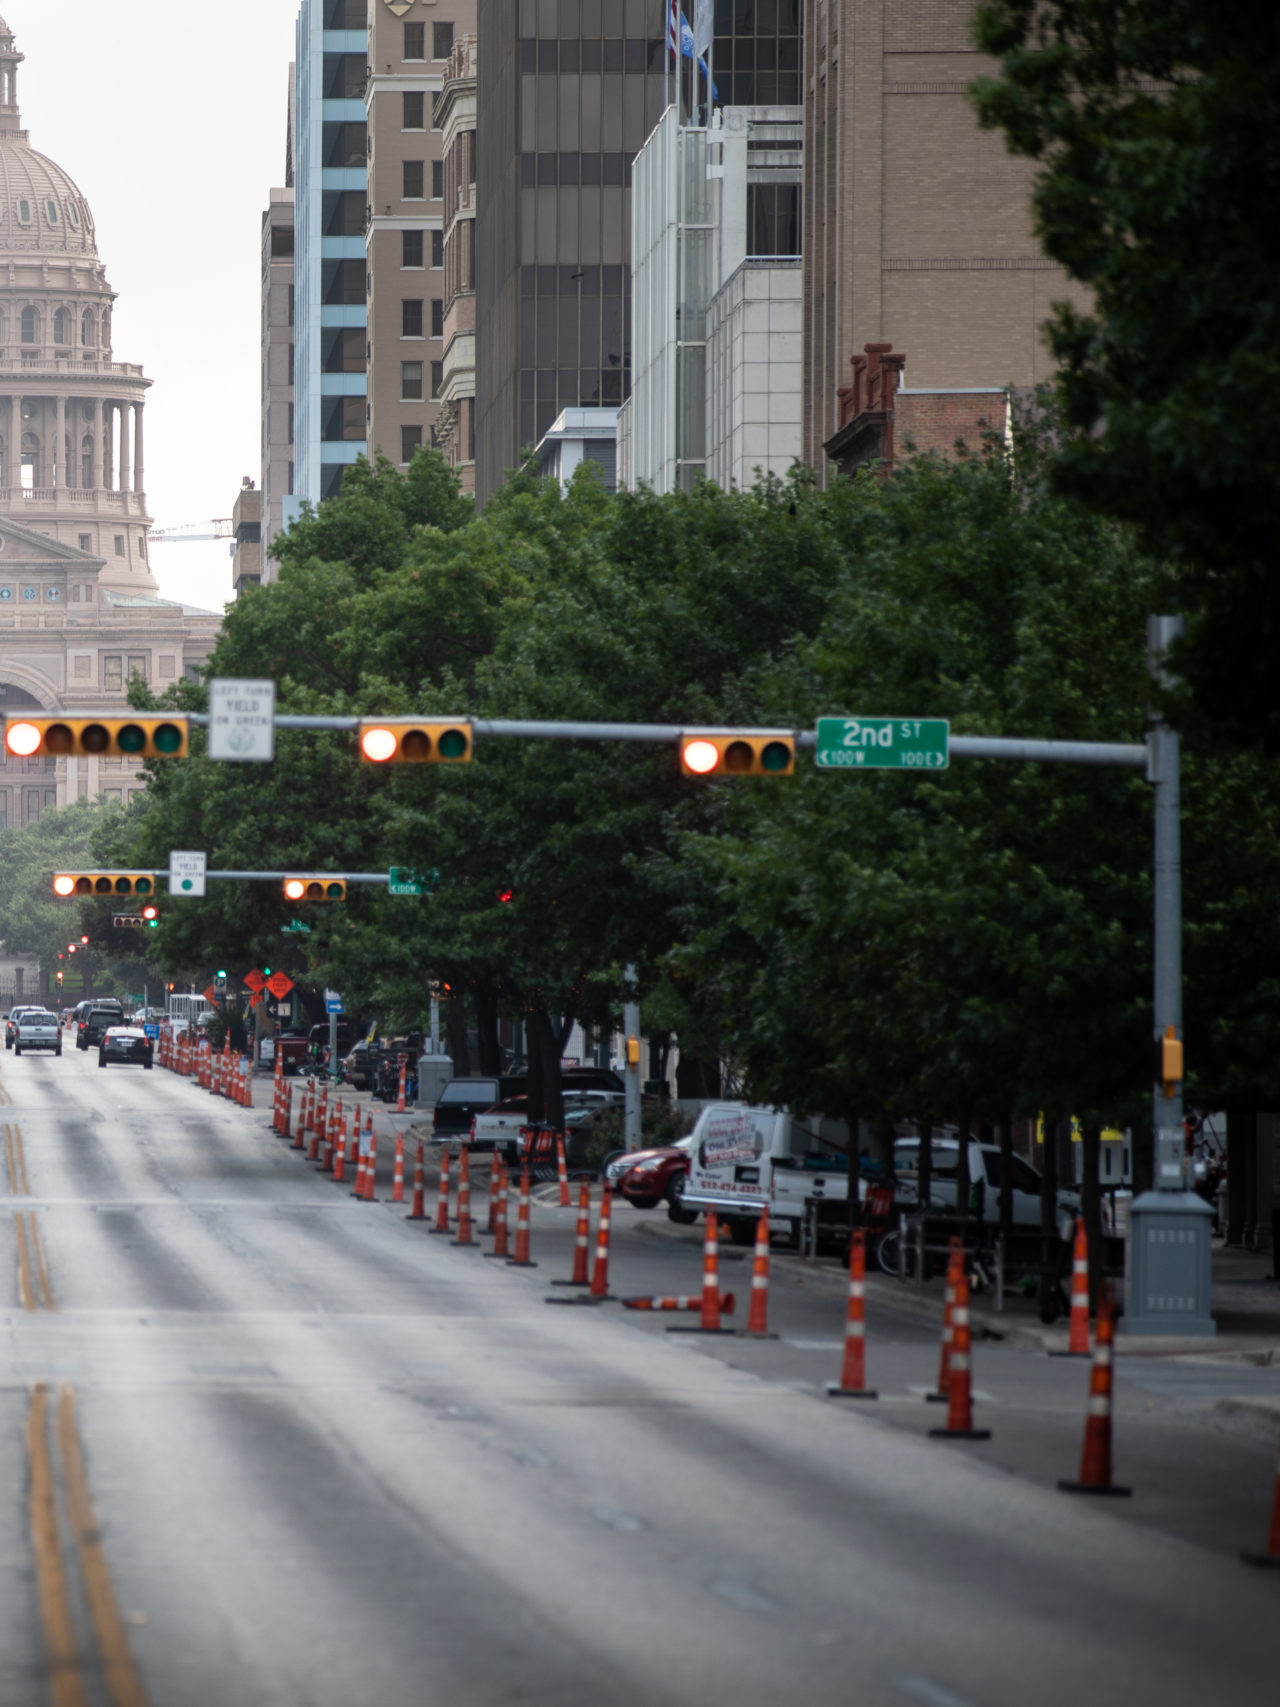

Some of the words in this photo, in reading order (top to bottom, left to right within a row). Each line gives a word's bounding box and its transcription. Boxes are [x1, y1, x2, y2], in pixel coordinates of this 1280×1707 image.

[215, 686, 238, 696] LEFT
[244, 686, 271, 696] TURN
[226, 700, 259, 712] YIELD
[215, 716, 229, 725] ON
[236, 716, 268, 726] GREEN
[843, 721, 893, 747] 2nd
[901, 723, 922, 738] ST
[831, 751, 865, 765] 100W
[901, 752, 933, 766] 100E
